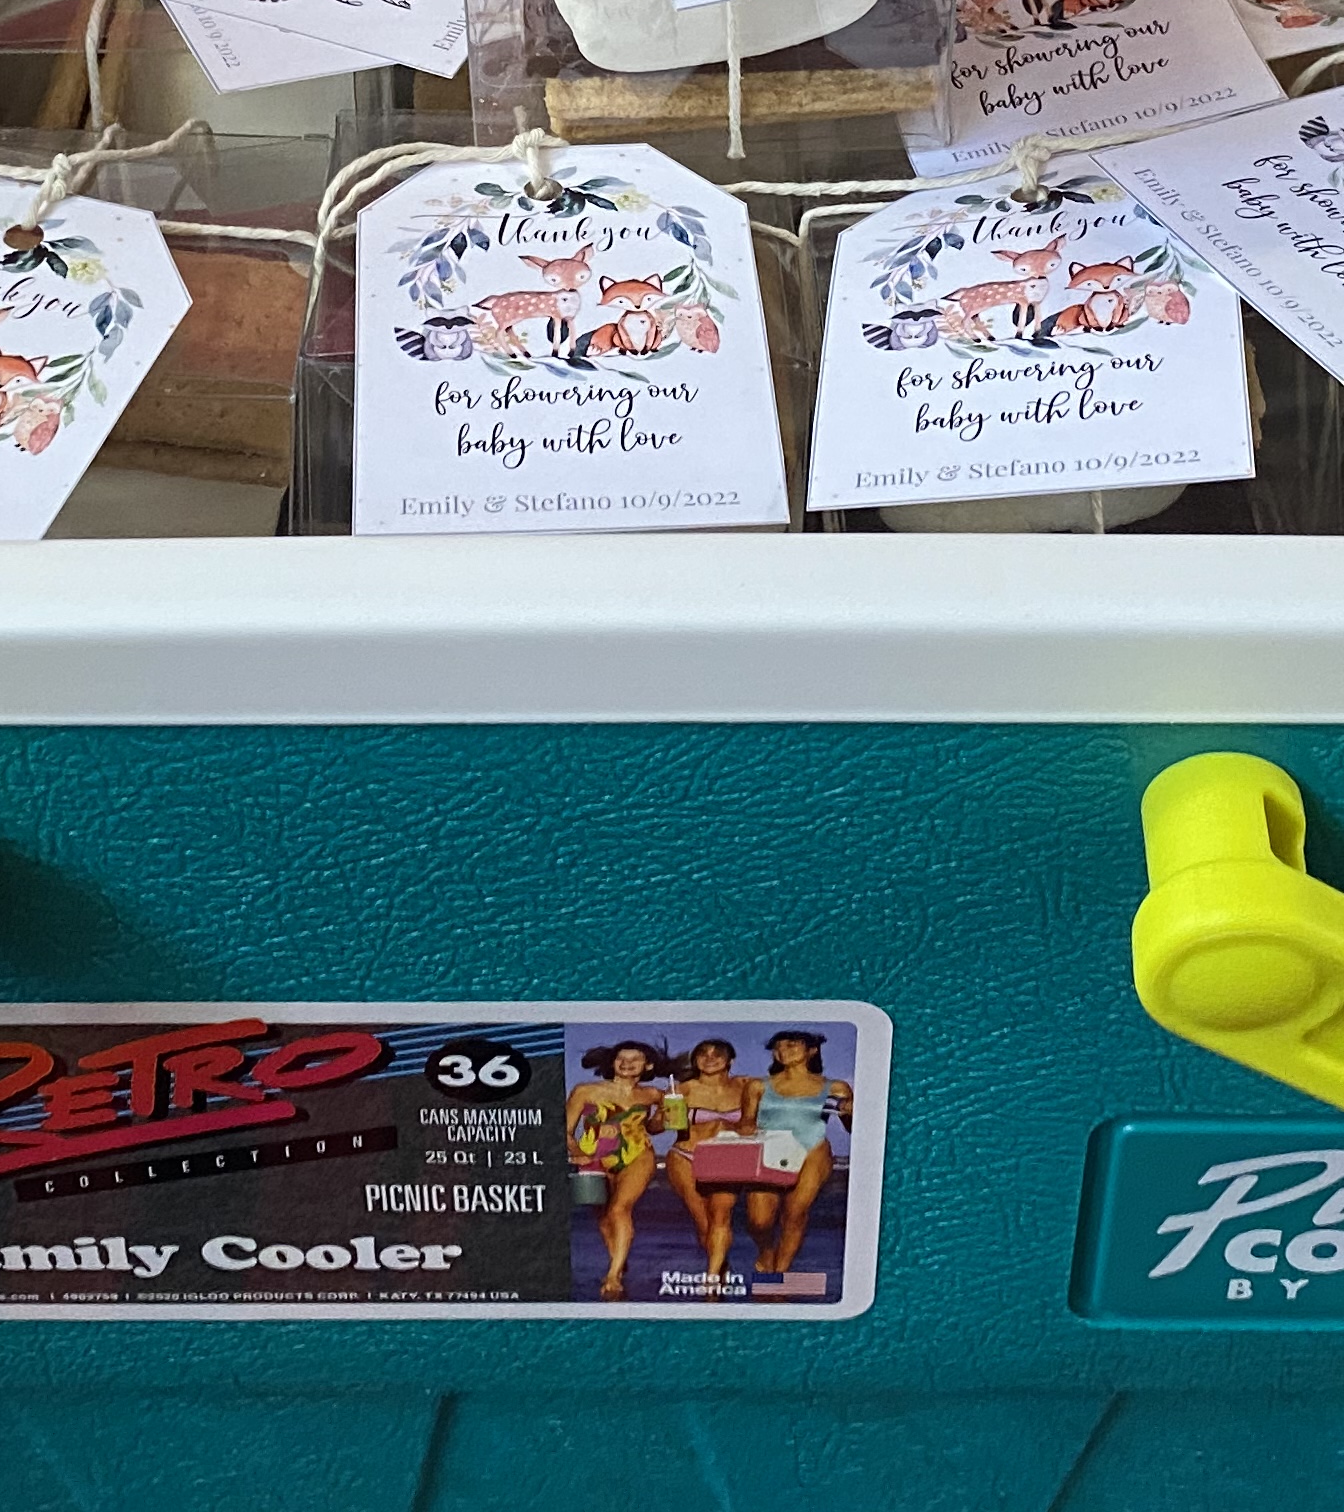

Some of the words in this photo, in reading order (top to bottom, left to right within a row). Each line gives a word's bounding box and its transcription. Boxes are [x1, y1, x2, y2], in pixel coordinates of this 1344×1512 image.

[949, 58, 989, 89] for
[994, 33, 1120, 78] showering
[1120, 17, 1170, 39] our
[979, 82, 1045, 118] baby
[1052, 60, 1111, 96] with
[1112, 53, 1170, 83] love
[1045, 112, 1129, 138] Stefano
[1133, 86, 1238, 121] 10/9/2022
[1253, 154, 1298, 180] for
[1222, 177, 1281, 220] baby
[497, 212, 601, 247] thank
[593, 224, 657, 252] you
[971, 211, 1068, 245] thank
[1068, 213, 1135, 241] you
[1132, 167, 1185, 207] Emily
[1180, 208, 1205, 222] &
[1197, 219, 1263, 278] Stefano
[1258, 278, 1344, 349] 10/9/2022
[12, 290, 90, 320] you
[896, 366, 943, 399] for
[951, 357, 1103, 391] showering
[1110, 352, 1165, 374] our
[433, 380, 483, 415] for
[490, 375, 642, 420] showering
[647, 382, 700, 403] our
[914, 402, 991, 442] baby
[999, 390, 1072, 426] with
[1077, 388, 1144, 420] love
[455, 422, 534, 470] baby
[542, 419, 615, 455] with
[619, 417, 684, 453] love
[855, 466, 931, 490] Emily
[936, 463, 962, 481] &
[968, 456, 1067, 480] Stefano
[1074, 447, 1202, 474] 10/9/2022
[399, 493, 474, 518] Emily
[483, 494, 507, 513] &
[514, 490, 612, 514] Stefano
[620, 490, 742, 513] 10/9/2022
[437, 1054, 521, 1088] 36
[419, 1108, 459, 1126] CANS
[463, 1108, 543, 1126] MAXIMUM
[446, 1125, 518, 1143] CAPACITY
[44, 1135, 364, 1195] COLLECTION
[424, 1150, 449, 1165] 25
[453, 1150, 477, 1166] Qt
[503, 1150, 528, 1165] 23
[532, 1150, 544, 1165] L
[365, 1183, 447, 1213] PICNIC
[453, 1184, 546, 1214] BASKET
[201, 1235, 463, 1272] Cooler
[658, 1282, 747, 1297] America
[661, 1270, 721, 1284] Made
[1225, 1278, 1310, 1301] BY
[183, 1291, 230, 1301] IGLOO
[233, 1291, 314, 1301] PRODUCTS
